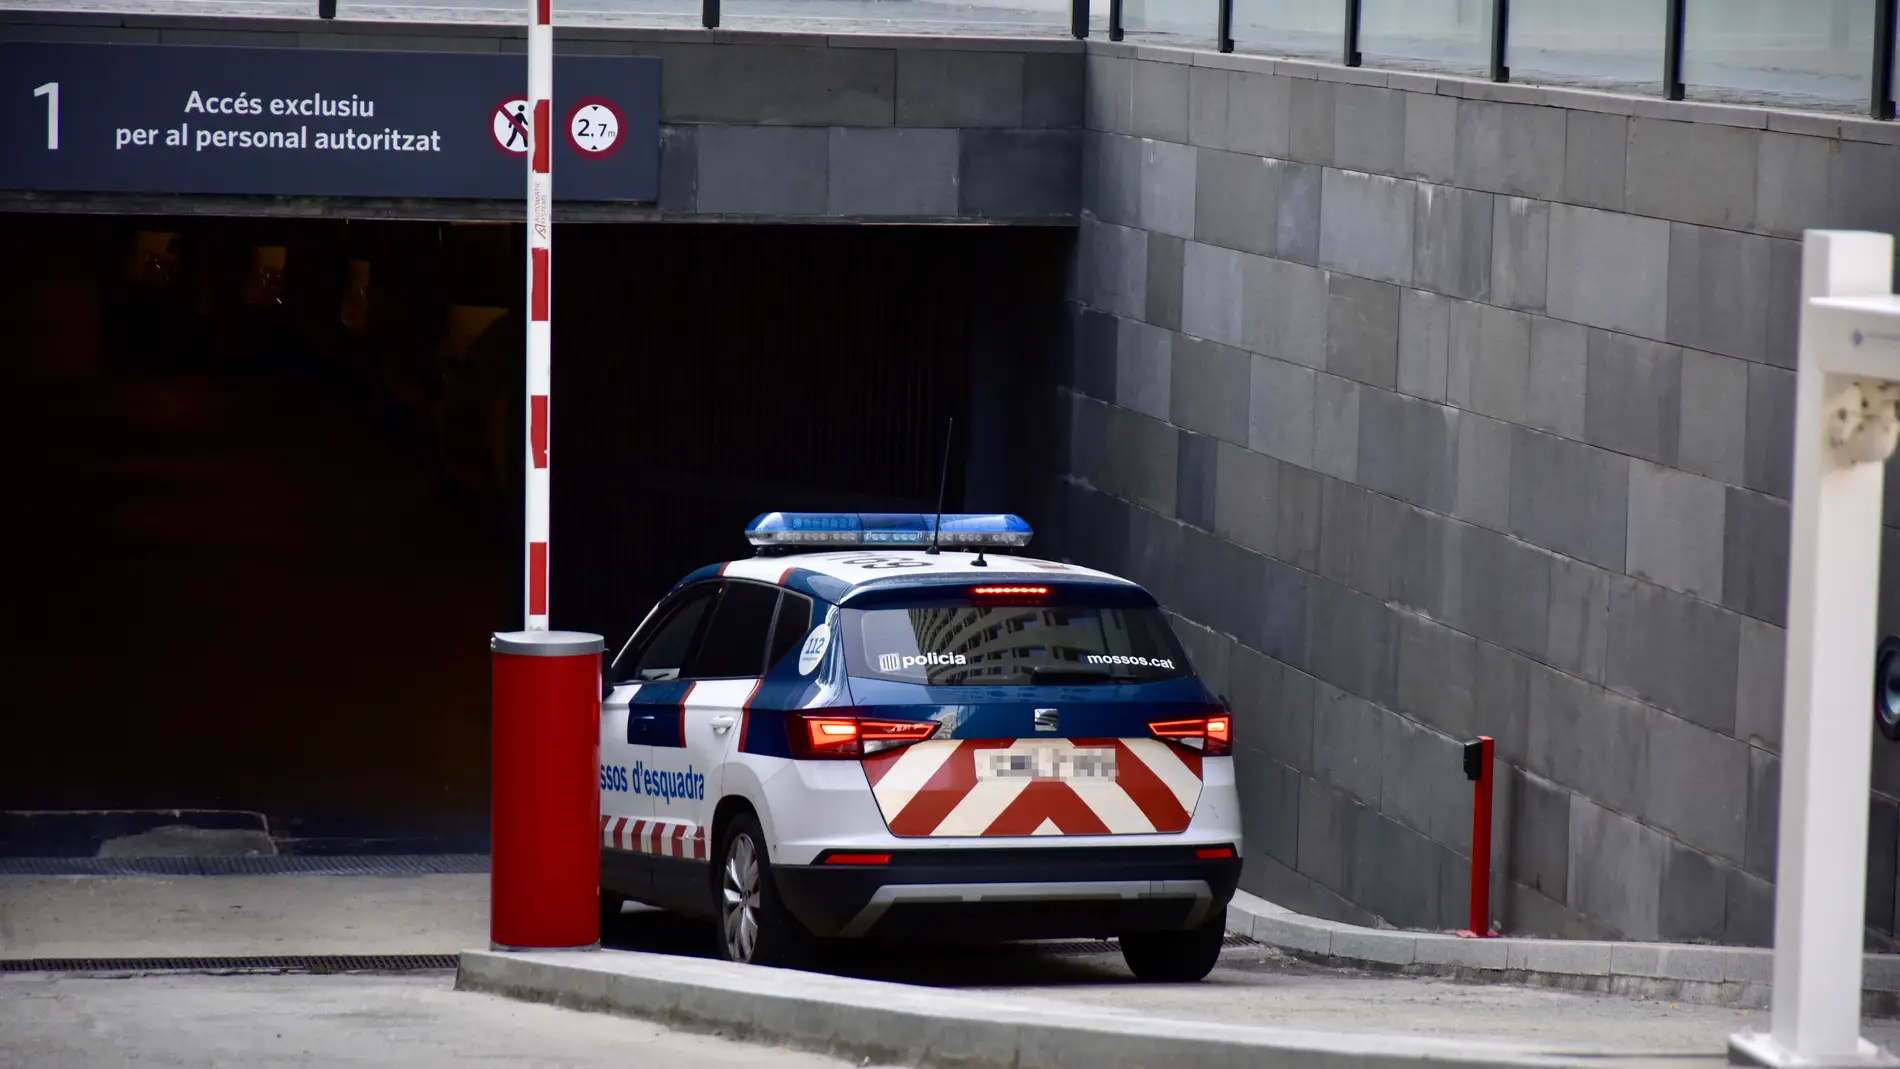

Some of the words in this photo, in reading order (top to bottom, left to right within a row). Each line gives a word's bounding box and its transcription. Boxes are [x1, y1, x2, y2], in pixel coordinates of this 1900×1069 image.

[33, 82, 60, 150] 1
[184, 89, 263, 115] Accés
[269, 92, 374, 118] exclusiu
[115, 128, 160, 150] per
[165, 122, 188, 147] al
[196, 125, 307, 152] personal
[314, 127, 441, 152] autoritzat
[804, 636, 826, 655] 112
[902, 652, 967, 669] policia
[1086, 654, 1176, 670] mossos.cat
[631, 760, 705, 805] d'esquadra
